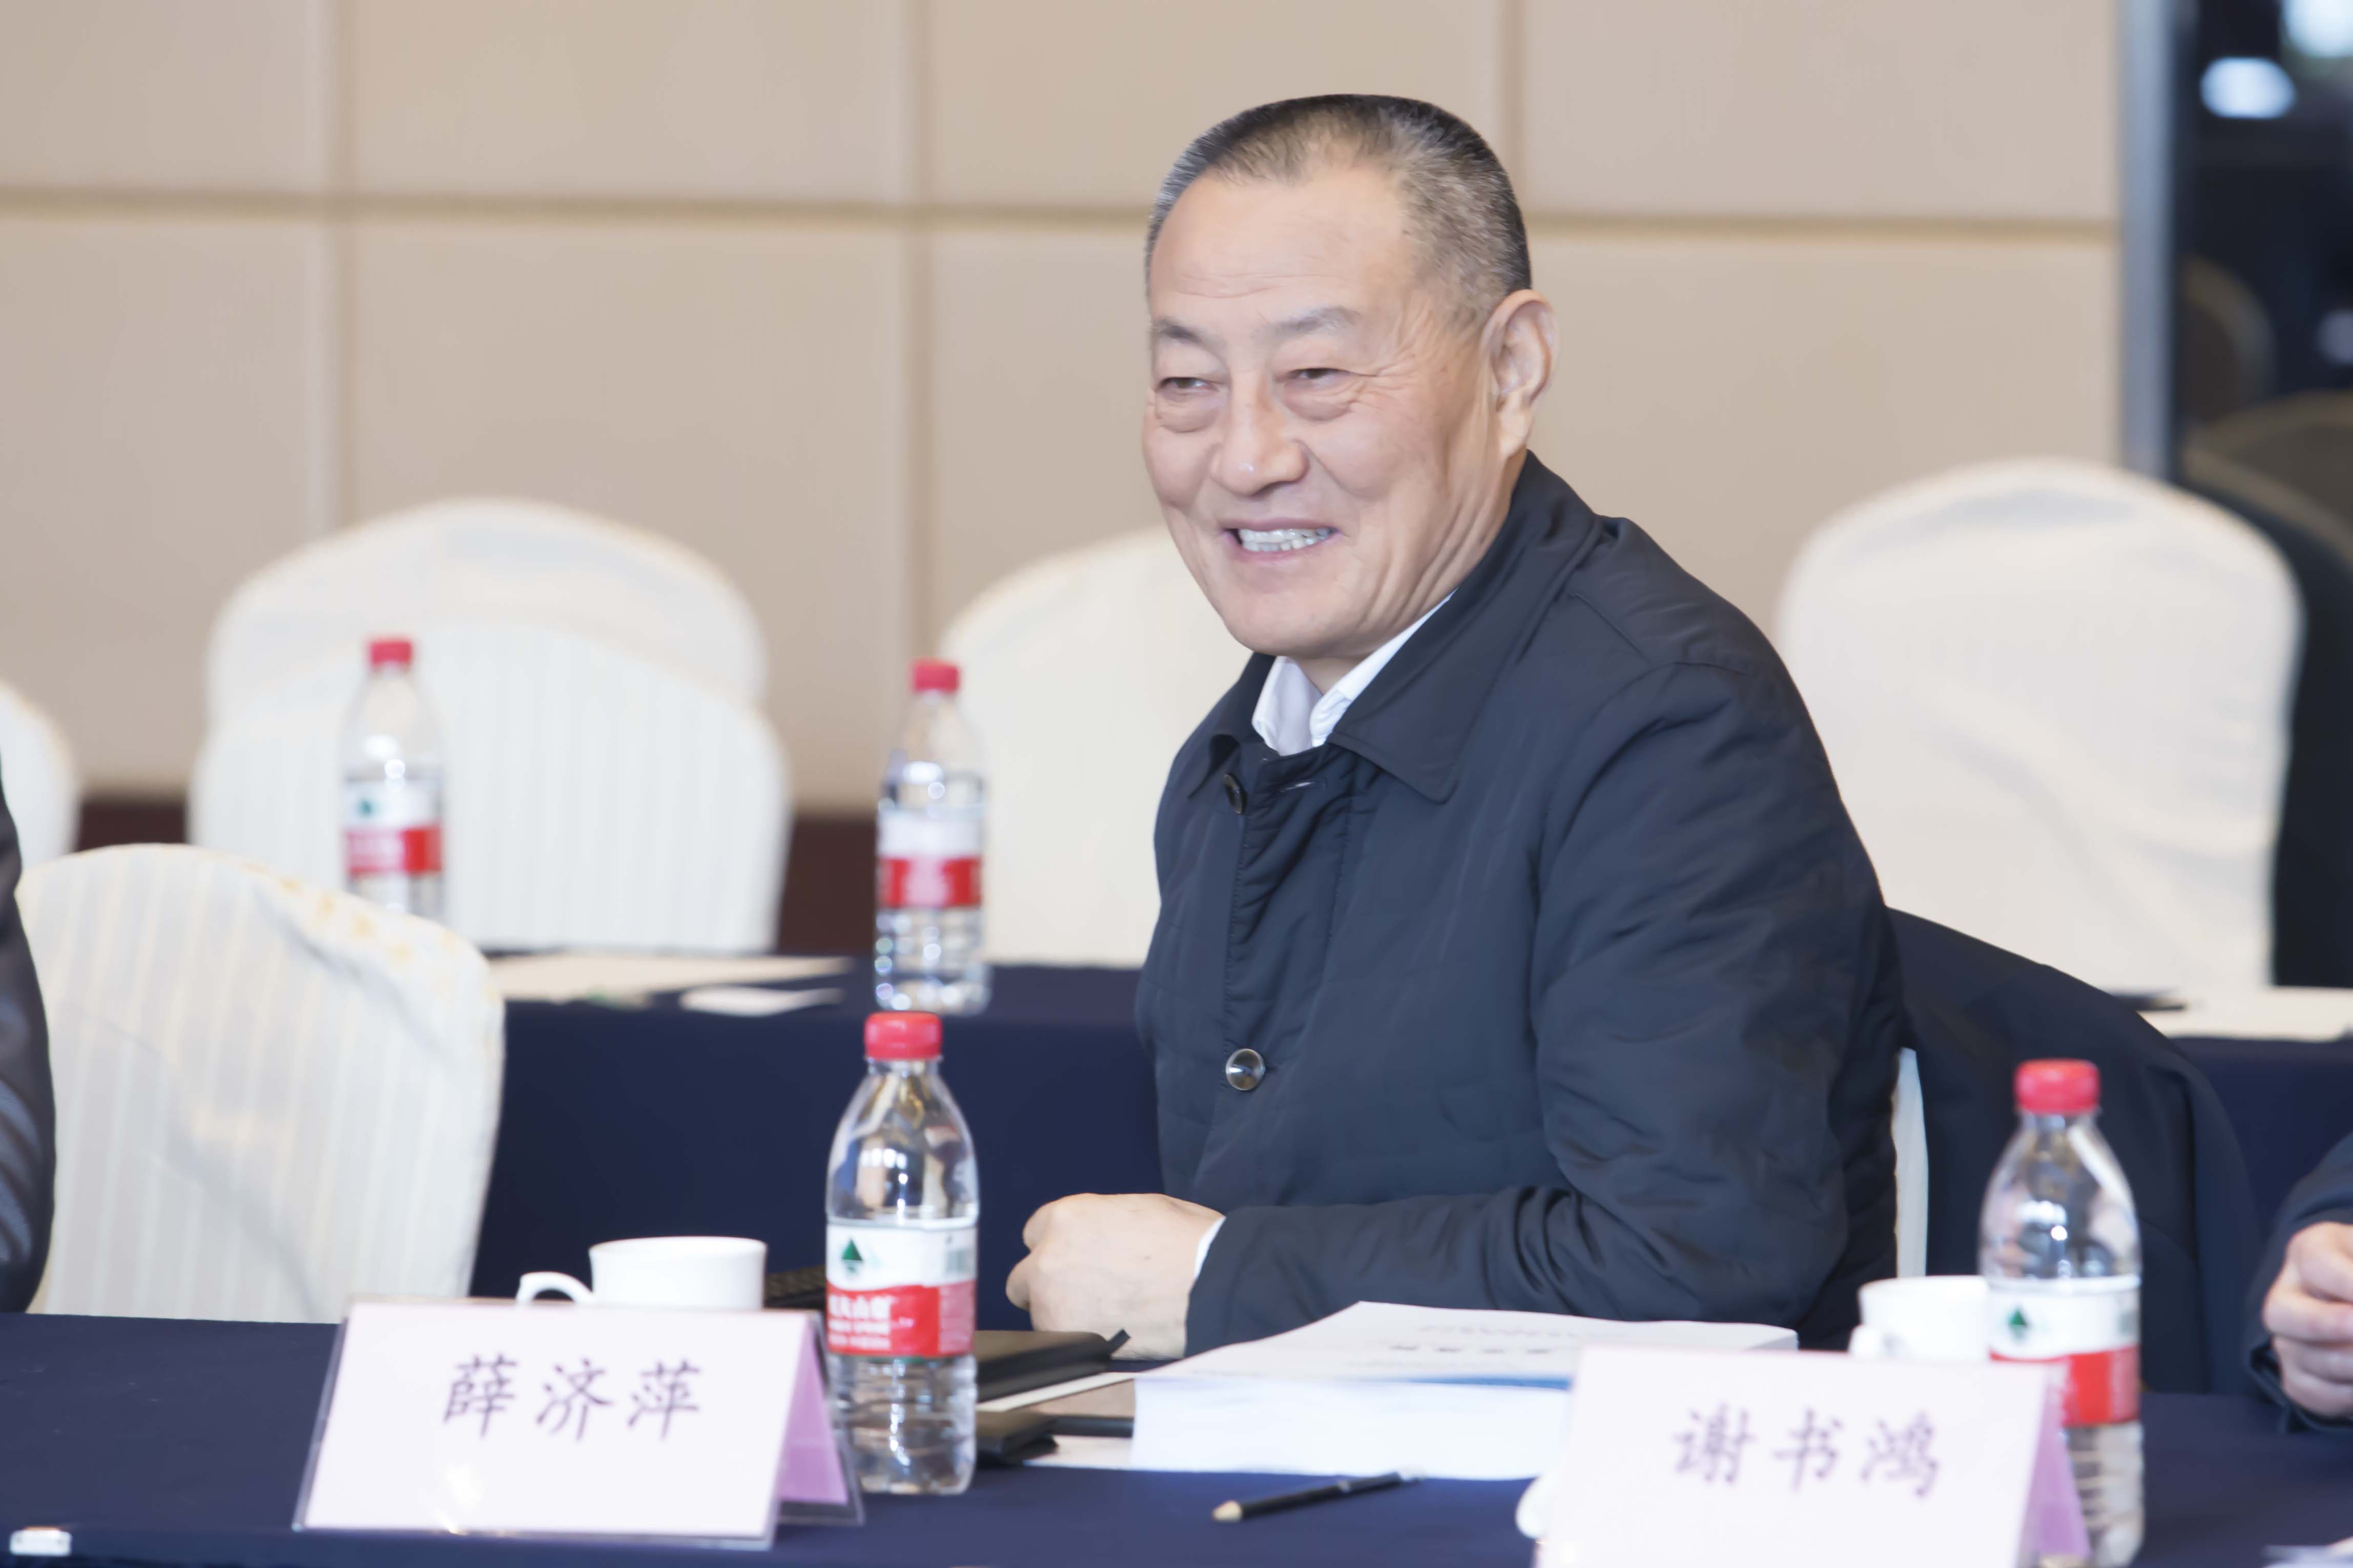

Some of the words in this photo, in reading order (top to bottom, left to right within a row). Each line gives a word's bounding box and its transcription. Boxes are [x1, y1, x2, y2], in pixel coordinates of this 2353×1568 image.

[443, 1353, 700, 1440] 薛济萍
[1674, 1403, 1939, 1498] 谢书鸿
